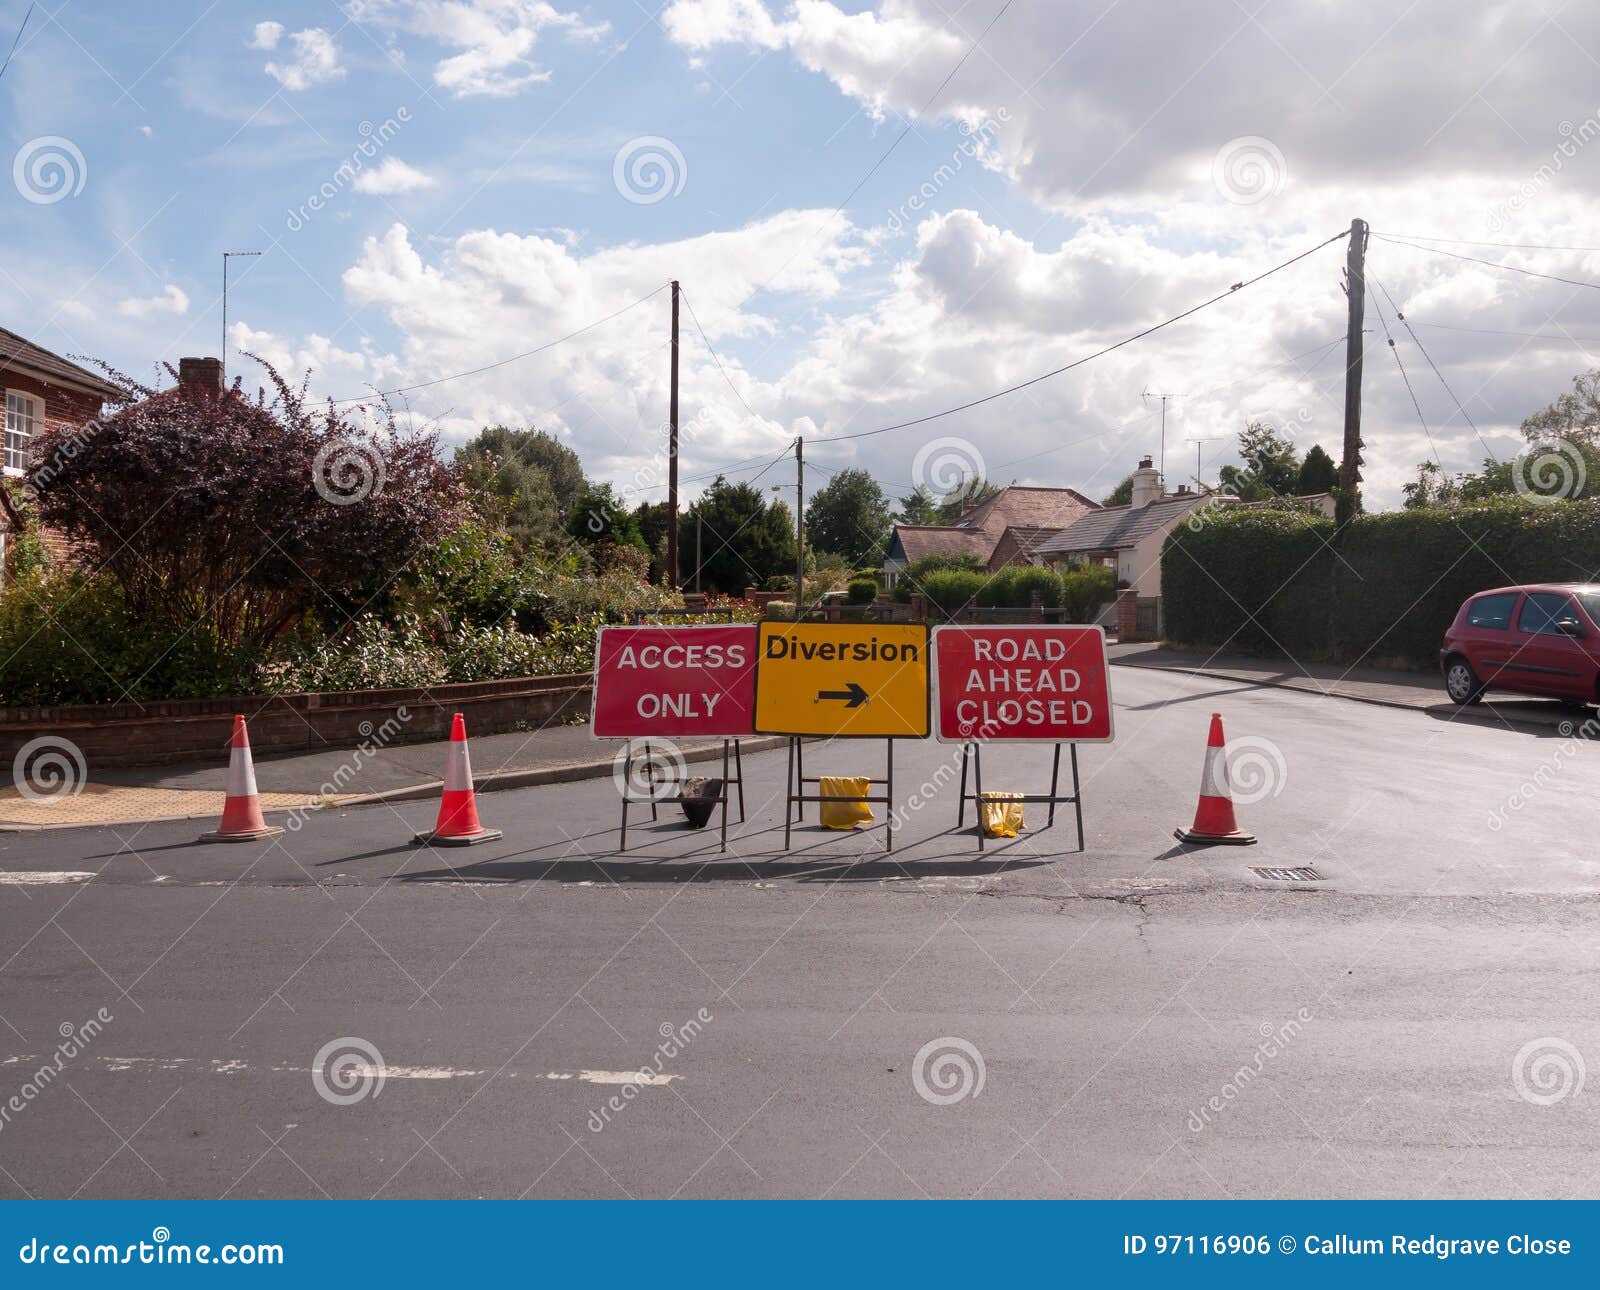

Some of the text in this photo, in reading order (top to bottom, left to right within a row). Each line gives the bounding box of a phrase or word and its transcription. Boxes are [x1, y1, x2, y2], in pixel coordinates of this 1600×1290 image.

[616, 644, 746, 670] ACCESS
[766, 635, 918, 662] Diversion
[973, 638, 1066, 662] ROAD
[965, 668, 1081, 693] AHEAD
[636, 692, 721, 719] ONLY
[956, 699, 1093, 726] CLOSED
